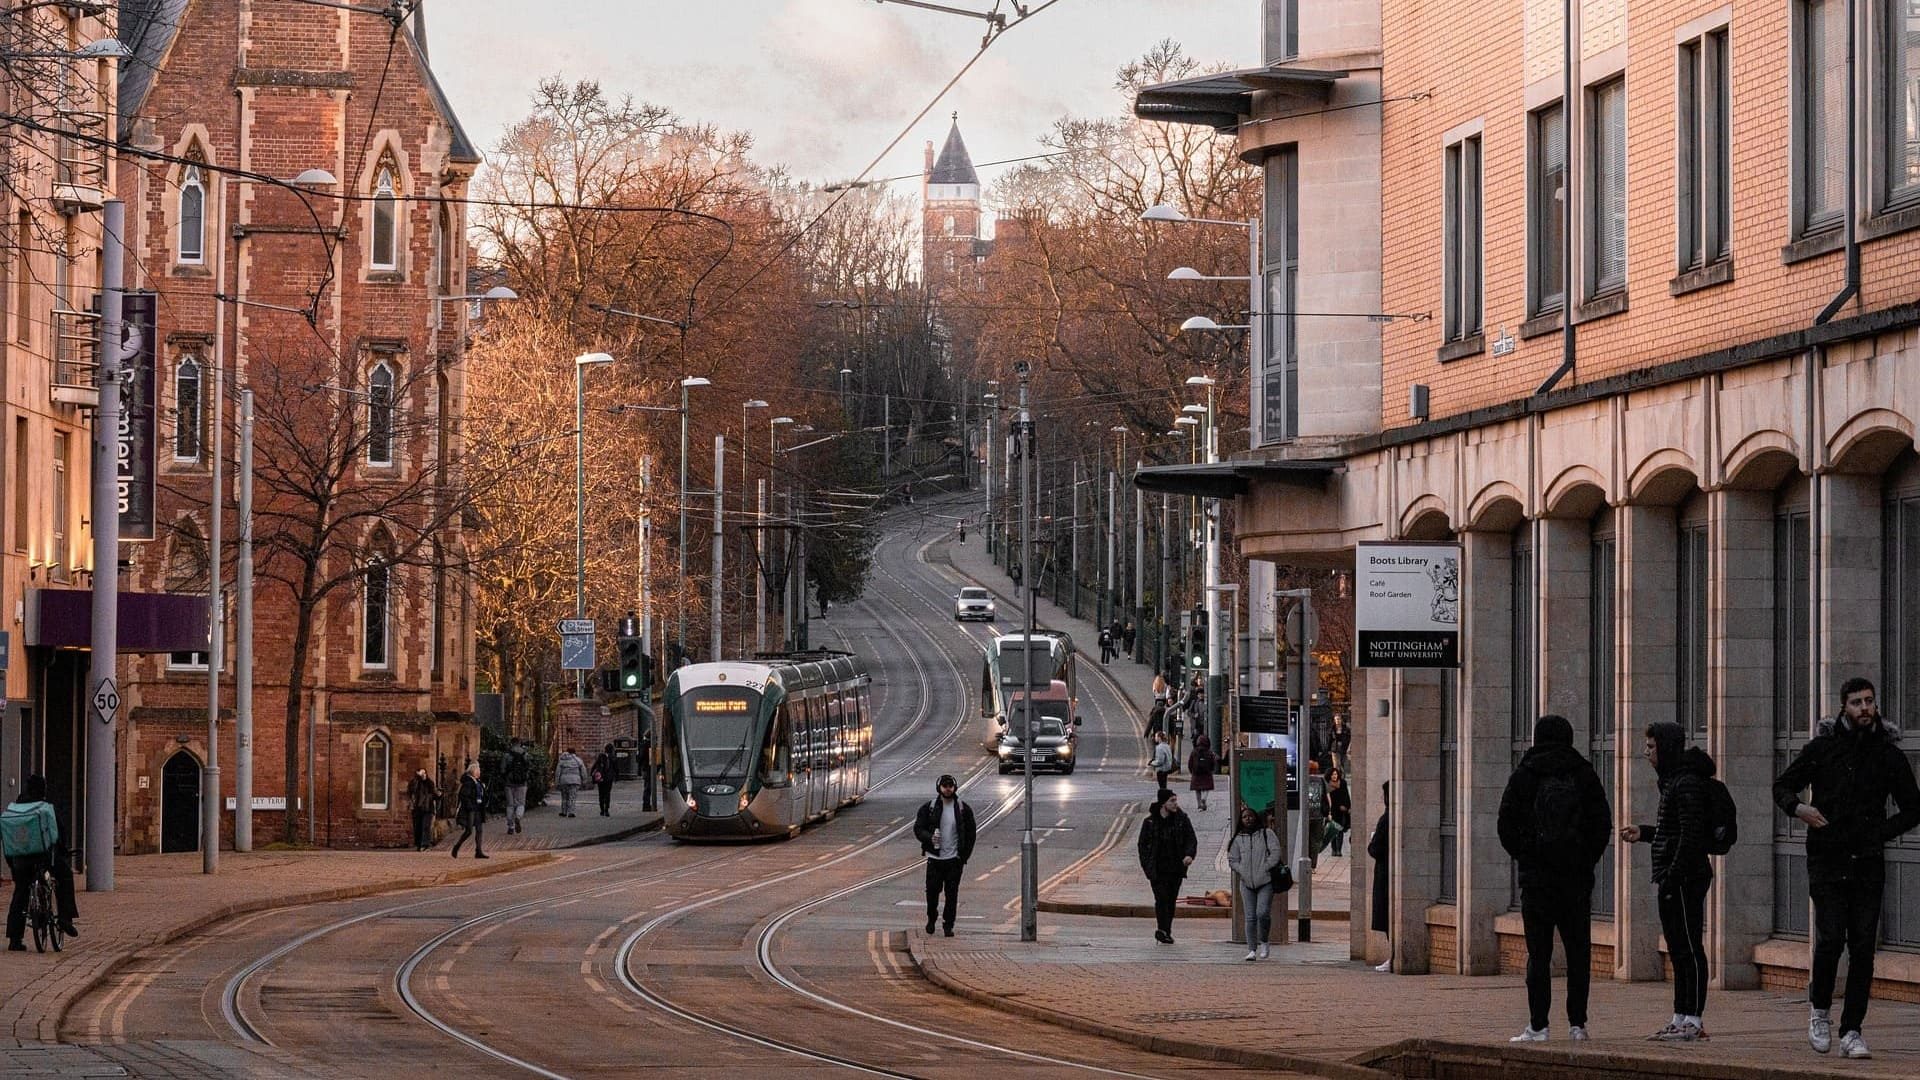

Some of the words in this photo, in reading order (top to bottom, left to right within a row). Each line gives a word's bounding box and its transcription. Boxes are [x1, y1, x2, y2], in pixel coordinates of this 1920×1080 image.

[118, 367, 135, 470] Pmier
[117, 475, 135, 514] Inn
[1370, 556, 1396, 565] Boots
[1398, 556, 1429, 567] Library
[1369, 641, 1443, 651] NOTTINGHAM
[745, 680, 764, 690] 227
[97, 693, 117, 710] 50
[728, 701, 747, 711] Park
